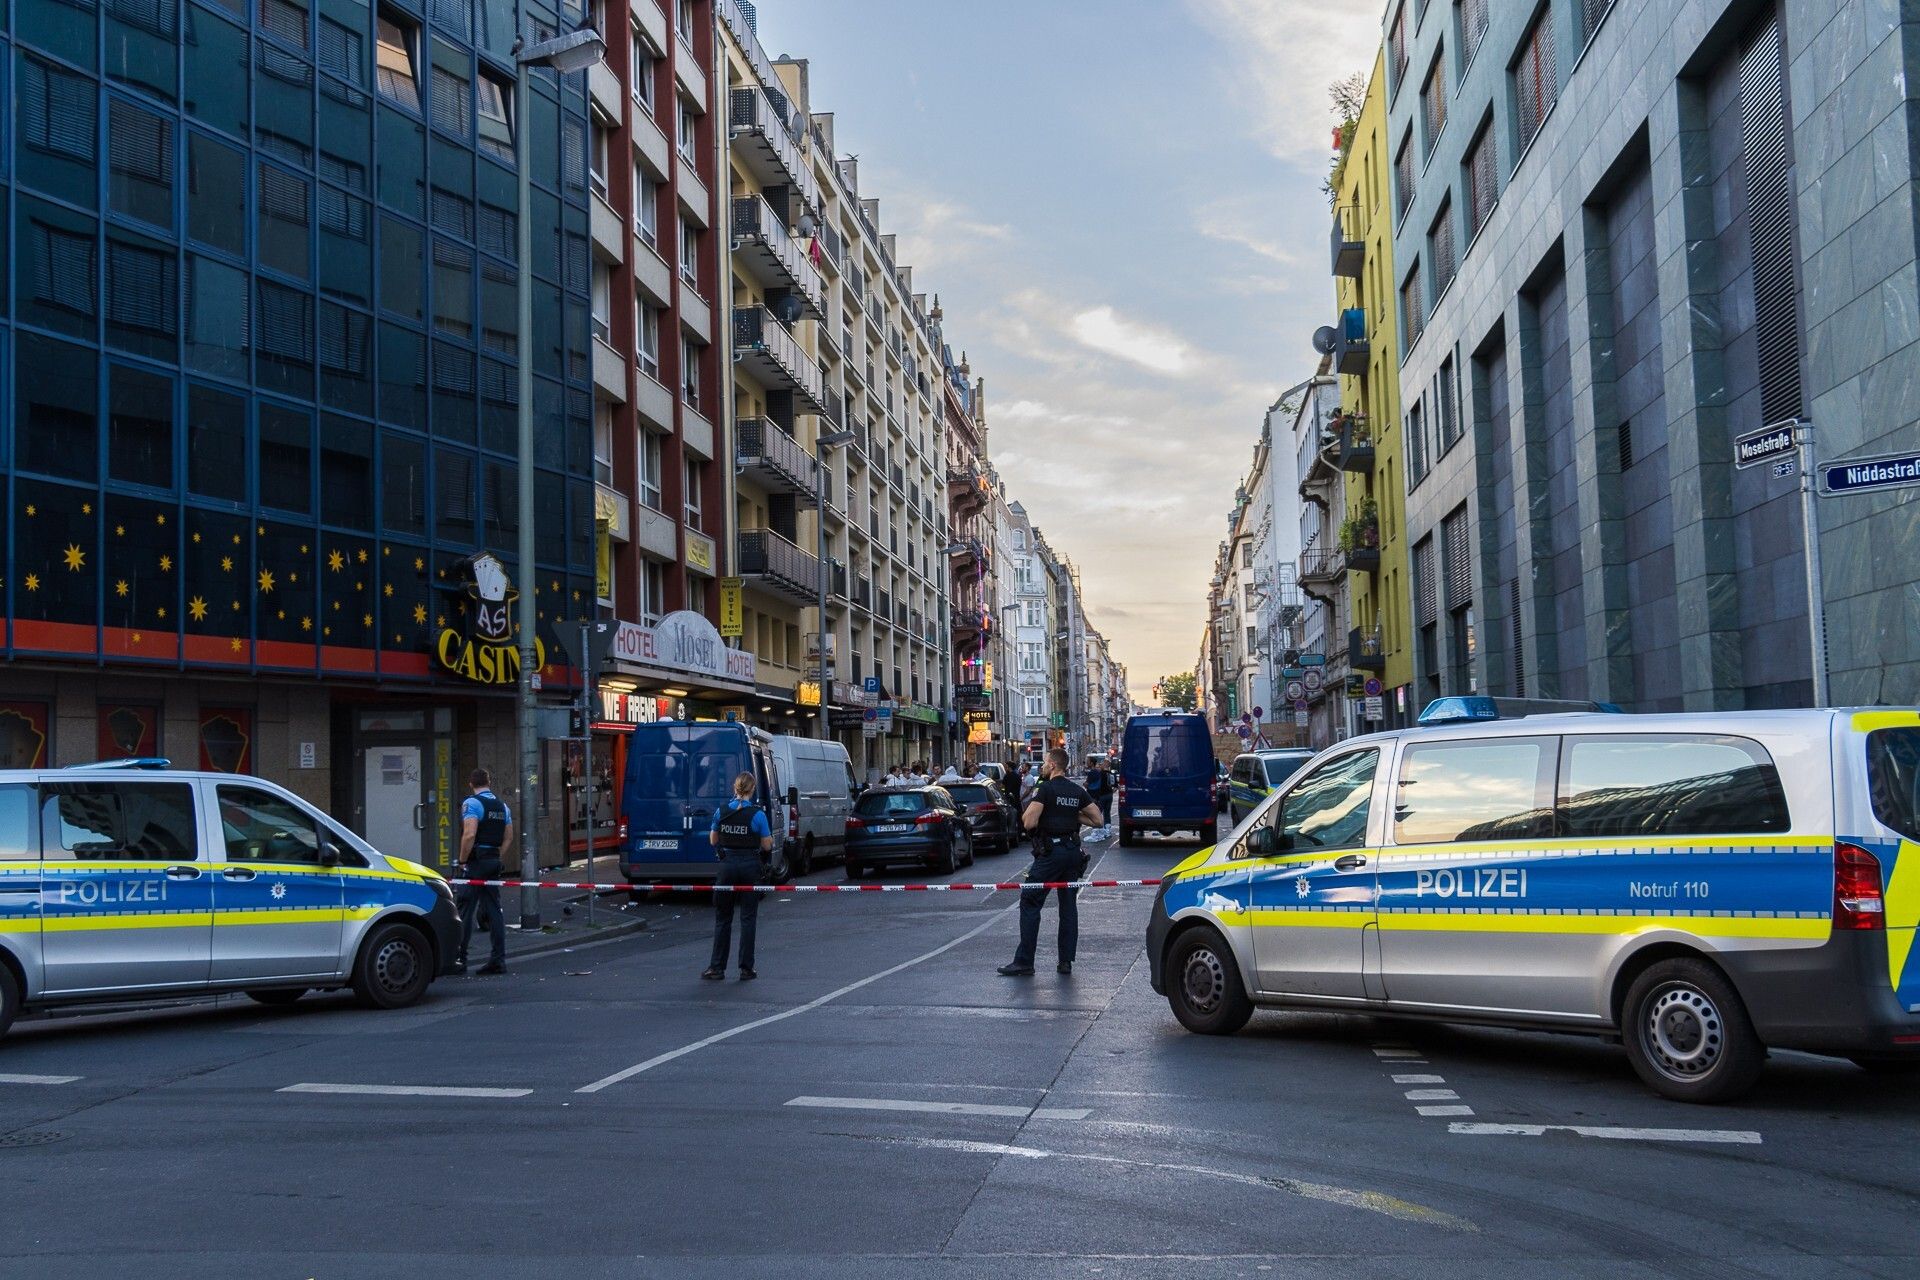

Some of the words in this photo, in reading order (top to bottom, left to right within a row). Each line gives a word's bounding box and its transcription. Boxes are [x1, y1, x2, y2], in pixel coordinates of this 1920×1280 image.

[1741, 432, 1790, 459] Moselstraße
[478, 604, 506, 637] AS
[617, 627, 658, 660] HOTEL
[726, 651, 755, 677] HOTEL
[628, 695, 657, 724] ARENA
[438, 743, 449, 866] SPIELHALLE
[1056, 796, 1079, 807] POLIZEI
[721, 824, 748, 836] POLIZEI
[59, 880, 167, 905] POLIZEI
[1416, 867, 1527, 898] POLIZEI
[1629, 880, 1679, 898] Notruf
[1682, 880, 1709, 898] 110
